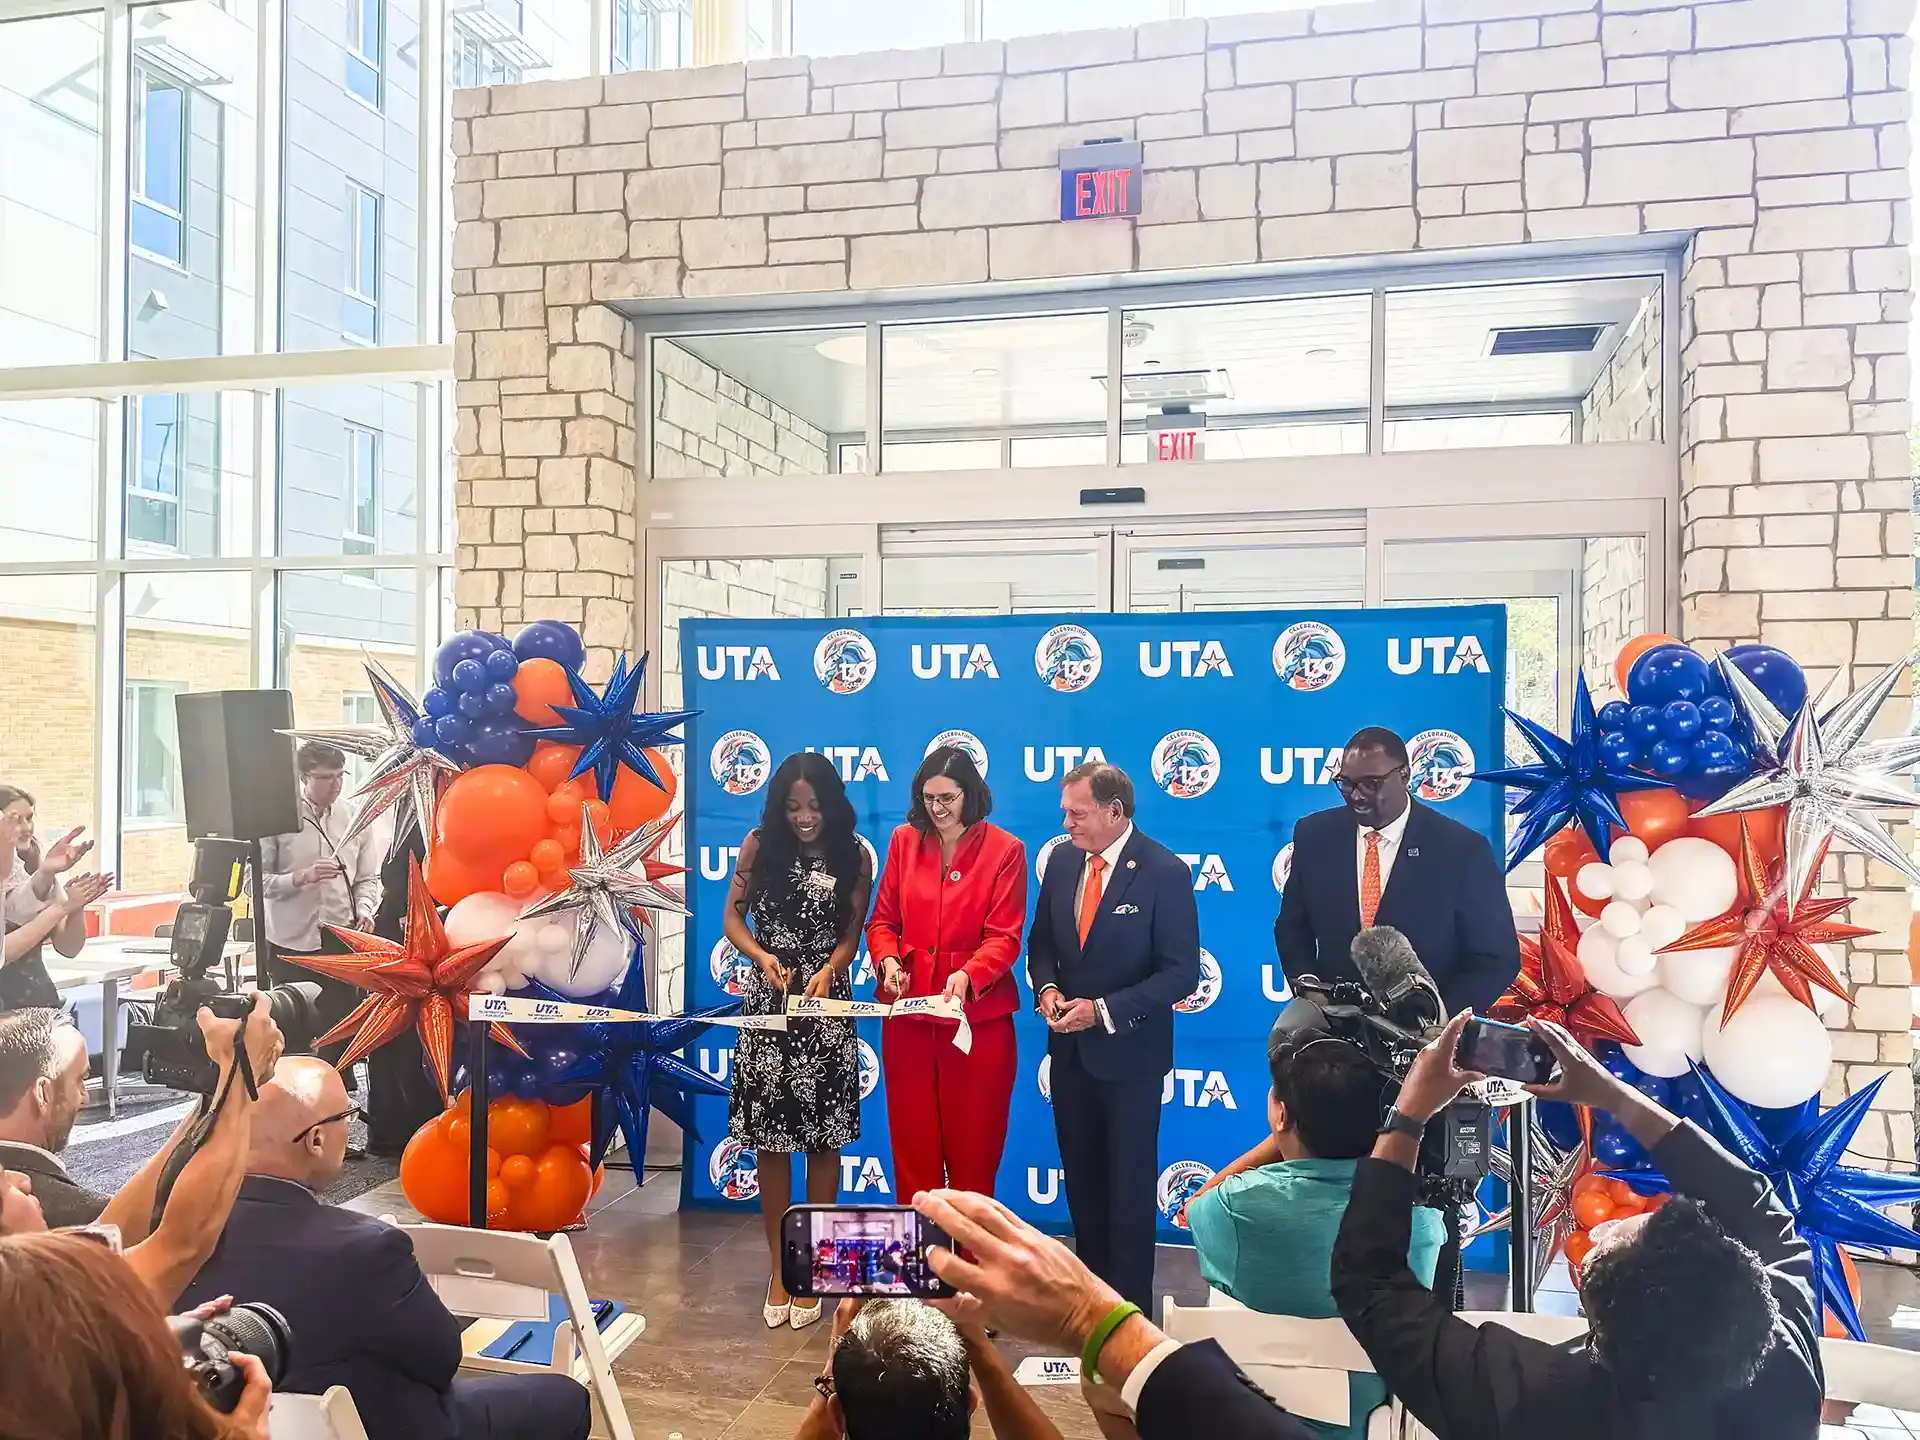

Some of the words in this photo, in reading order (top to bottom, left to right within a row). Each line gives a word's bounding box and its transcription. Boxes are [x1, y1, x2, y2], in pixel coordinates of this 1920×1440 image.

[1076, 169, 1131, 216] EXIT
[1158, 431, 1197, 461] EXIT
[1050, 626, 1087, 637] CELEBRATING
[1288, 623, 1329, 634] CELEBRATING
[827, 630, 862, 641] CELEBRATING
[1139, 640, 1234, 678] UTA
[1387, 635, 1491, 675] UTA
[697, 646, 781, 681] UTA
[911, 643, 1000, 680] UTA
[723, 731, 757, 742] CELEBRATING
[937, 731, 973, 742] CELEBRATING
[1166, 731, 1205, 742] CELEBRATING
[1416, 730, 1459, 742] CELEBRATING
[484, 999, 507, 1010] UTA
[535, 1003, 559, 1014] UTA
[797, 998, 821, 1008] UTA
[850, 1002, 876, 1011] UTA
[903, 998, 929, 1008] UTA
[587, 1008, 610, 1016] UTA
[1486, 1080, 1508, 1093] UTA
[1171, 1160, 1210, 1175] CELEBRATING
[1043, 1361, 1074, 1373] UTA
